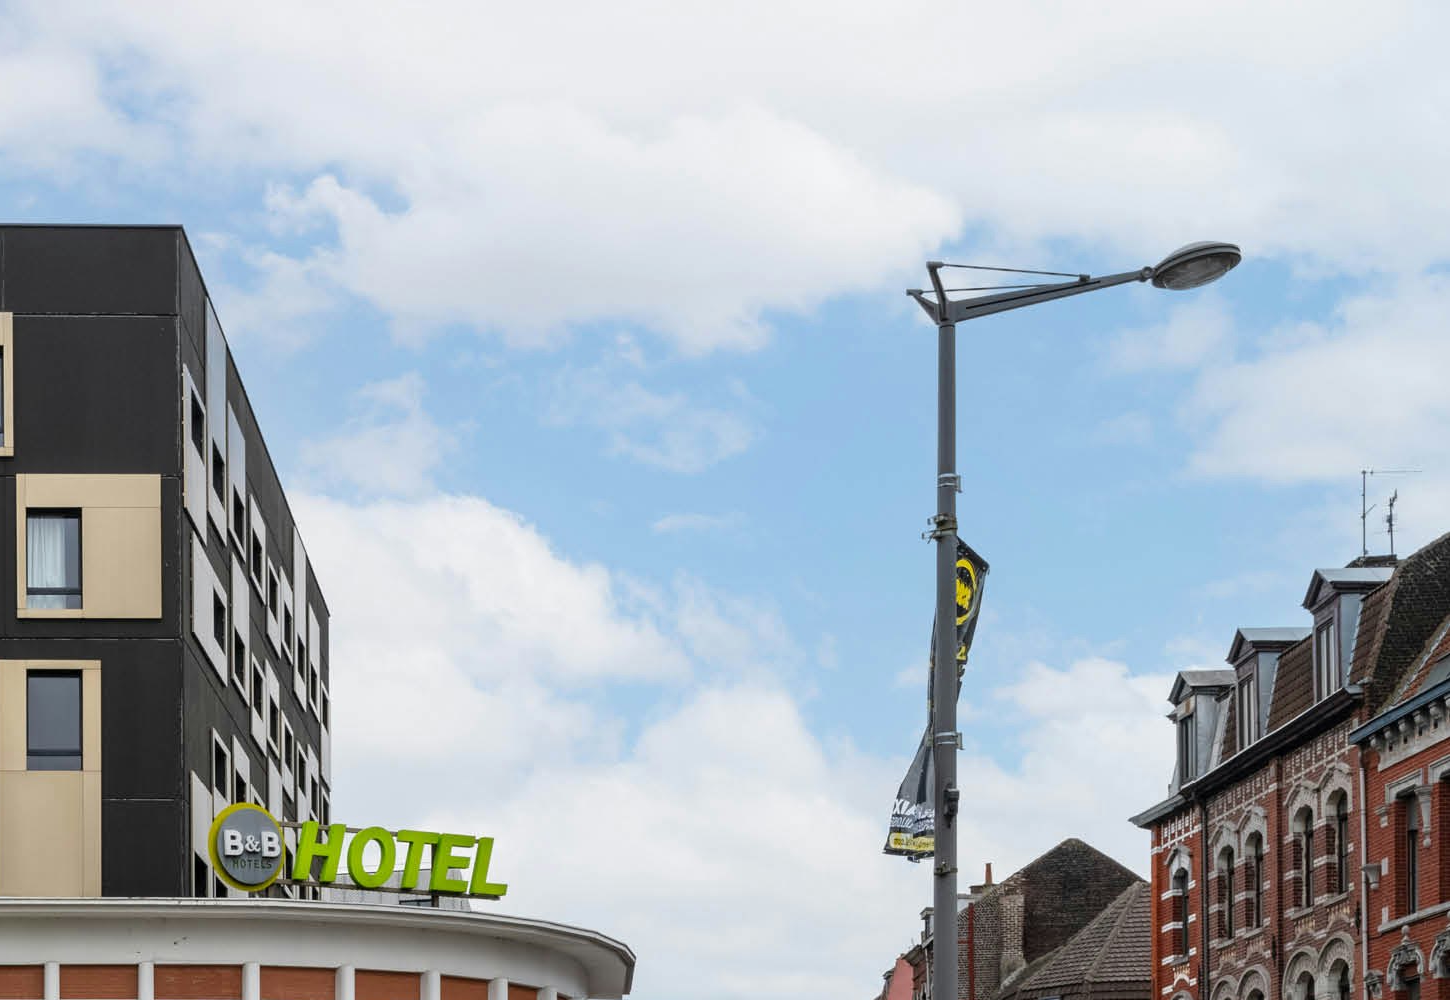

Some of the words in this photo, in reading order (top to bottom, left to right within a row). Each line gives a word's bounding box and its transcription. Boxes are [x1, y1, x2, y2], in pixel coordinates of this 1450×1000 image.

[224, 829, 281, 858] B&B
[232, 858, 272, 870] HOTELS
[292, 821, 507, 896] HOTEL
